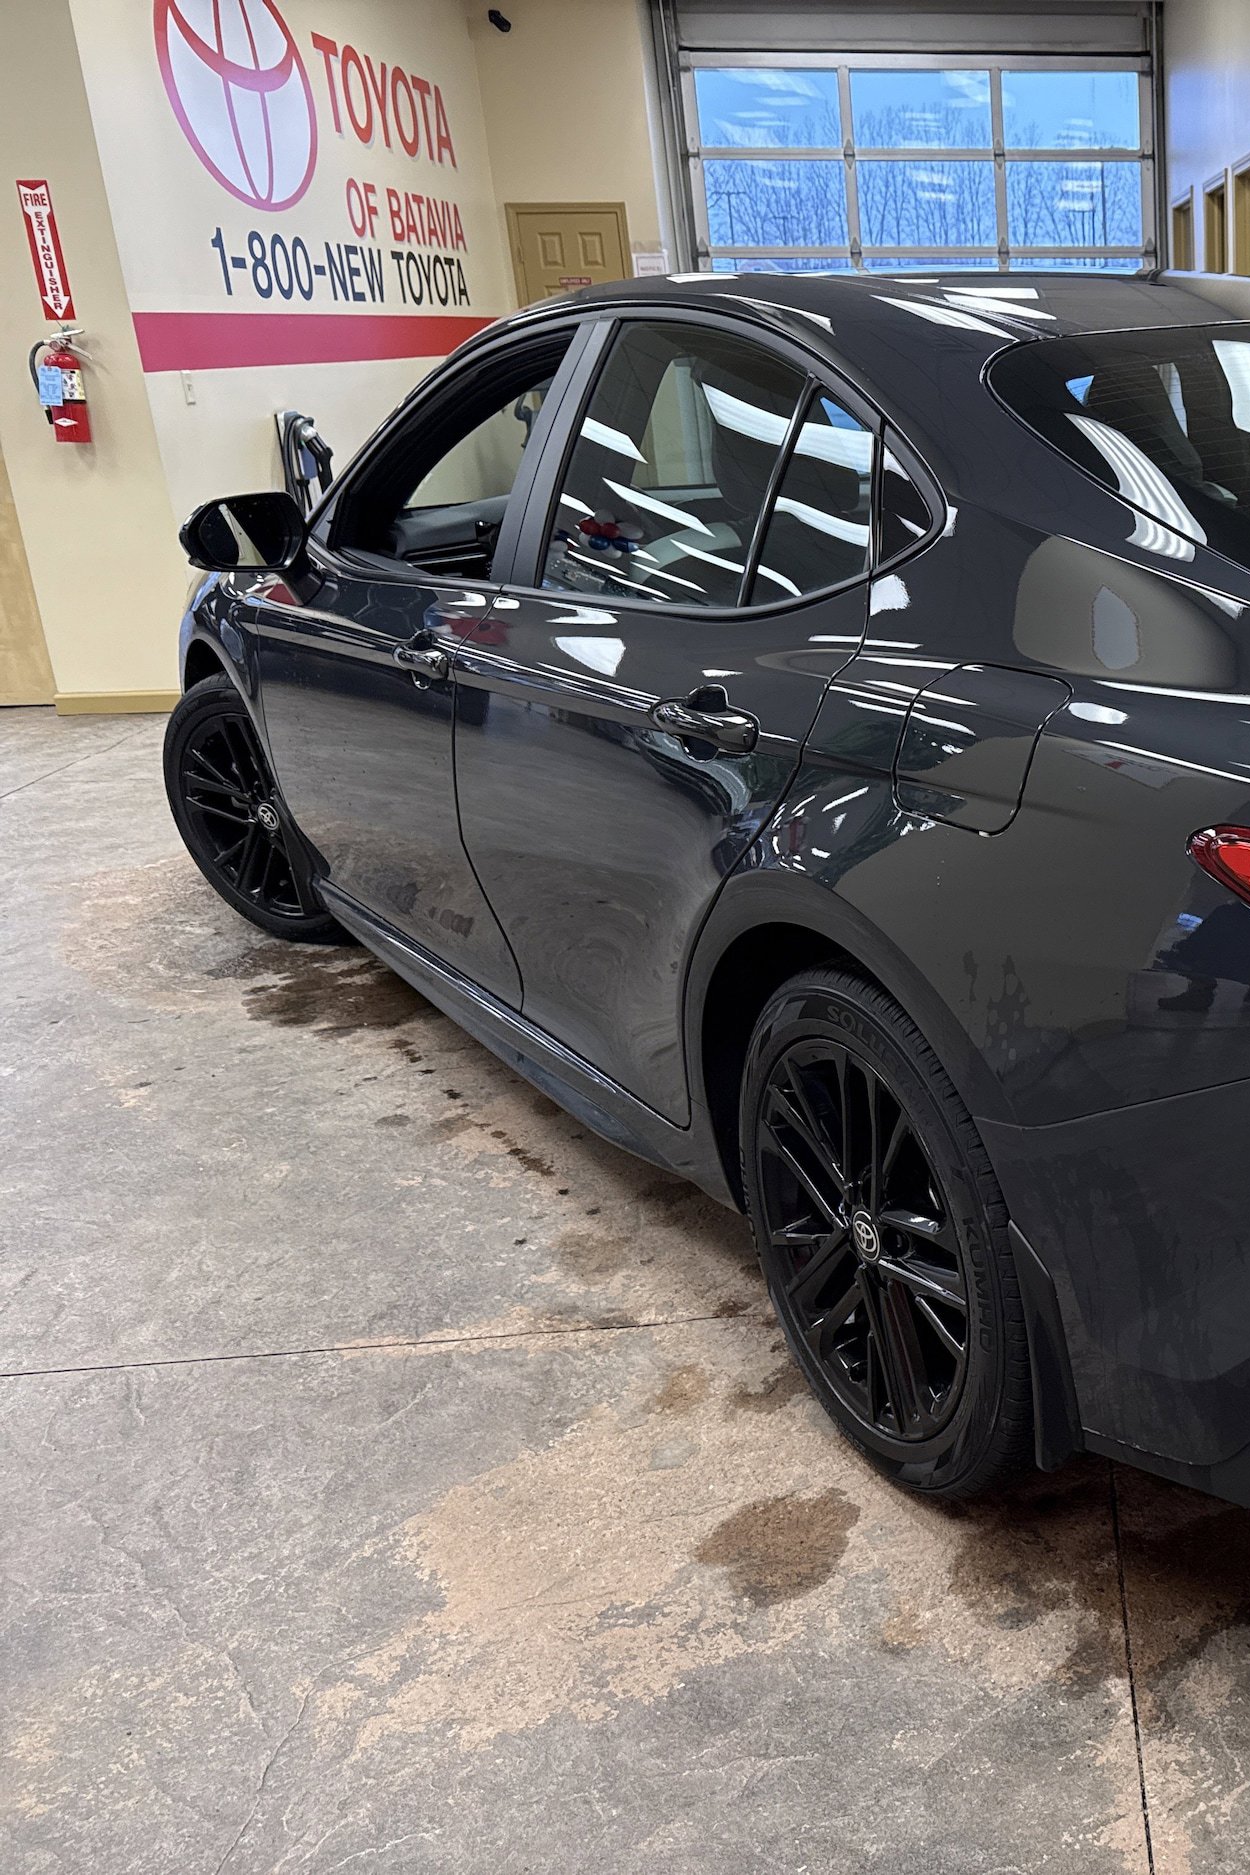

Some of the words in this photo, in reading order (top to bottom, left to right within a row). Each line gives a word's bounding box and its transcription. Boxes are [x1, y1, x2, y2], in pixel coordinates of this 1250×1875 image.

[310, 31, 457, 168] TOYOTA
[23, 193, 48, 206] FIRE
[346, 178, 378, 238] OF
[386, 188, 467, 252] BATAVIA
[34, 211, 63, 310] EXTINGUISHER
[211, 227, 385, 302] 1-800-NEW
[391, 250, 470, 306] TOYOTA
[961, 1216, 994, 1354] KUMHO
